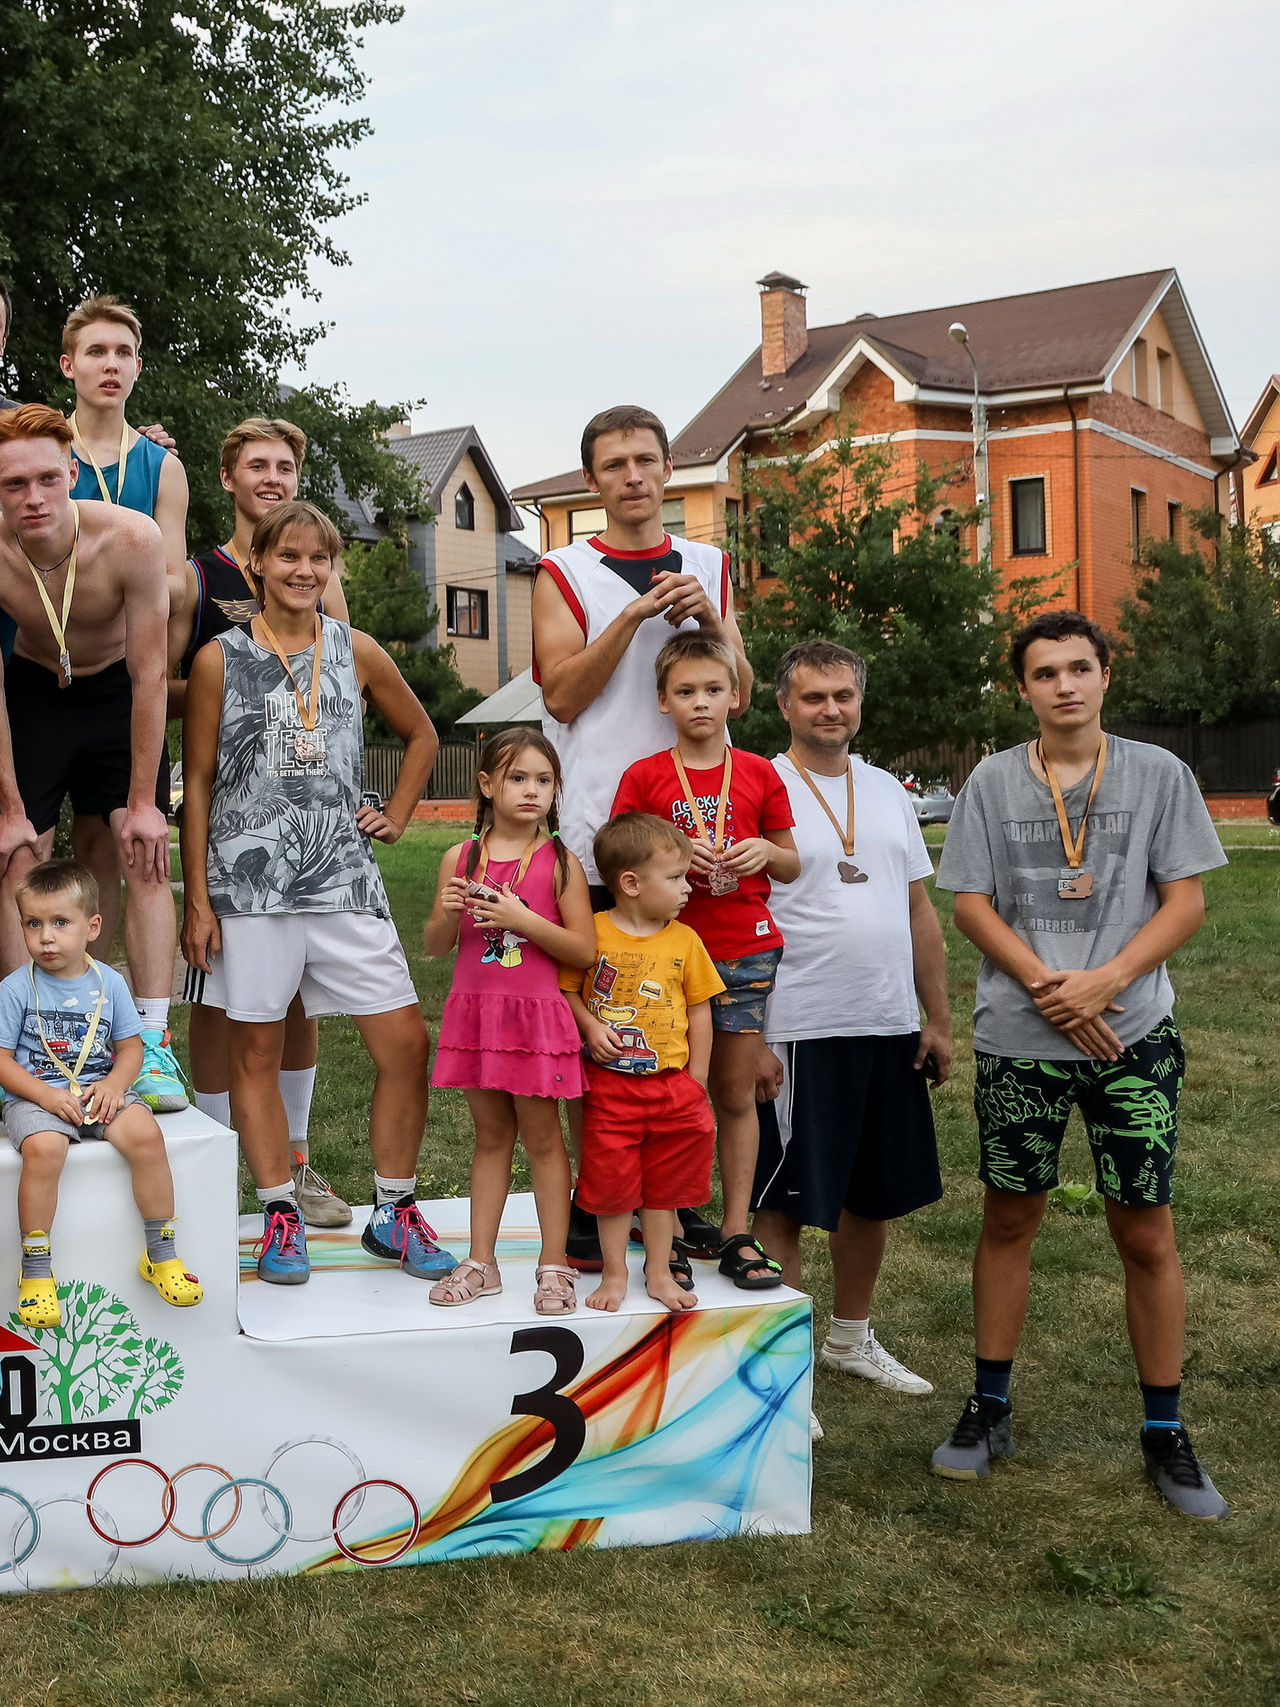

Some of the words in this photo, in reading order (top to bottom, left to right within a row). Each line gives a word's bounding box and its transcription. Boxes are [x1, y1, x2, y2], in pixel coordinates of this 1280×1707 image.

[280, 769, 305, 777] GETTING
[306, 768, 324, 776] THERE
[489, 1326, 586, 1504] 3
